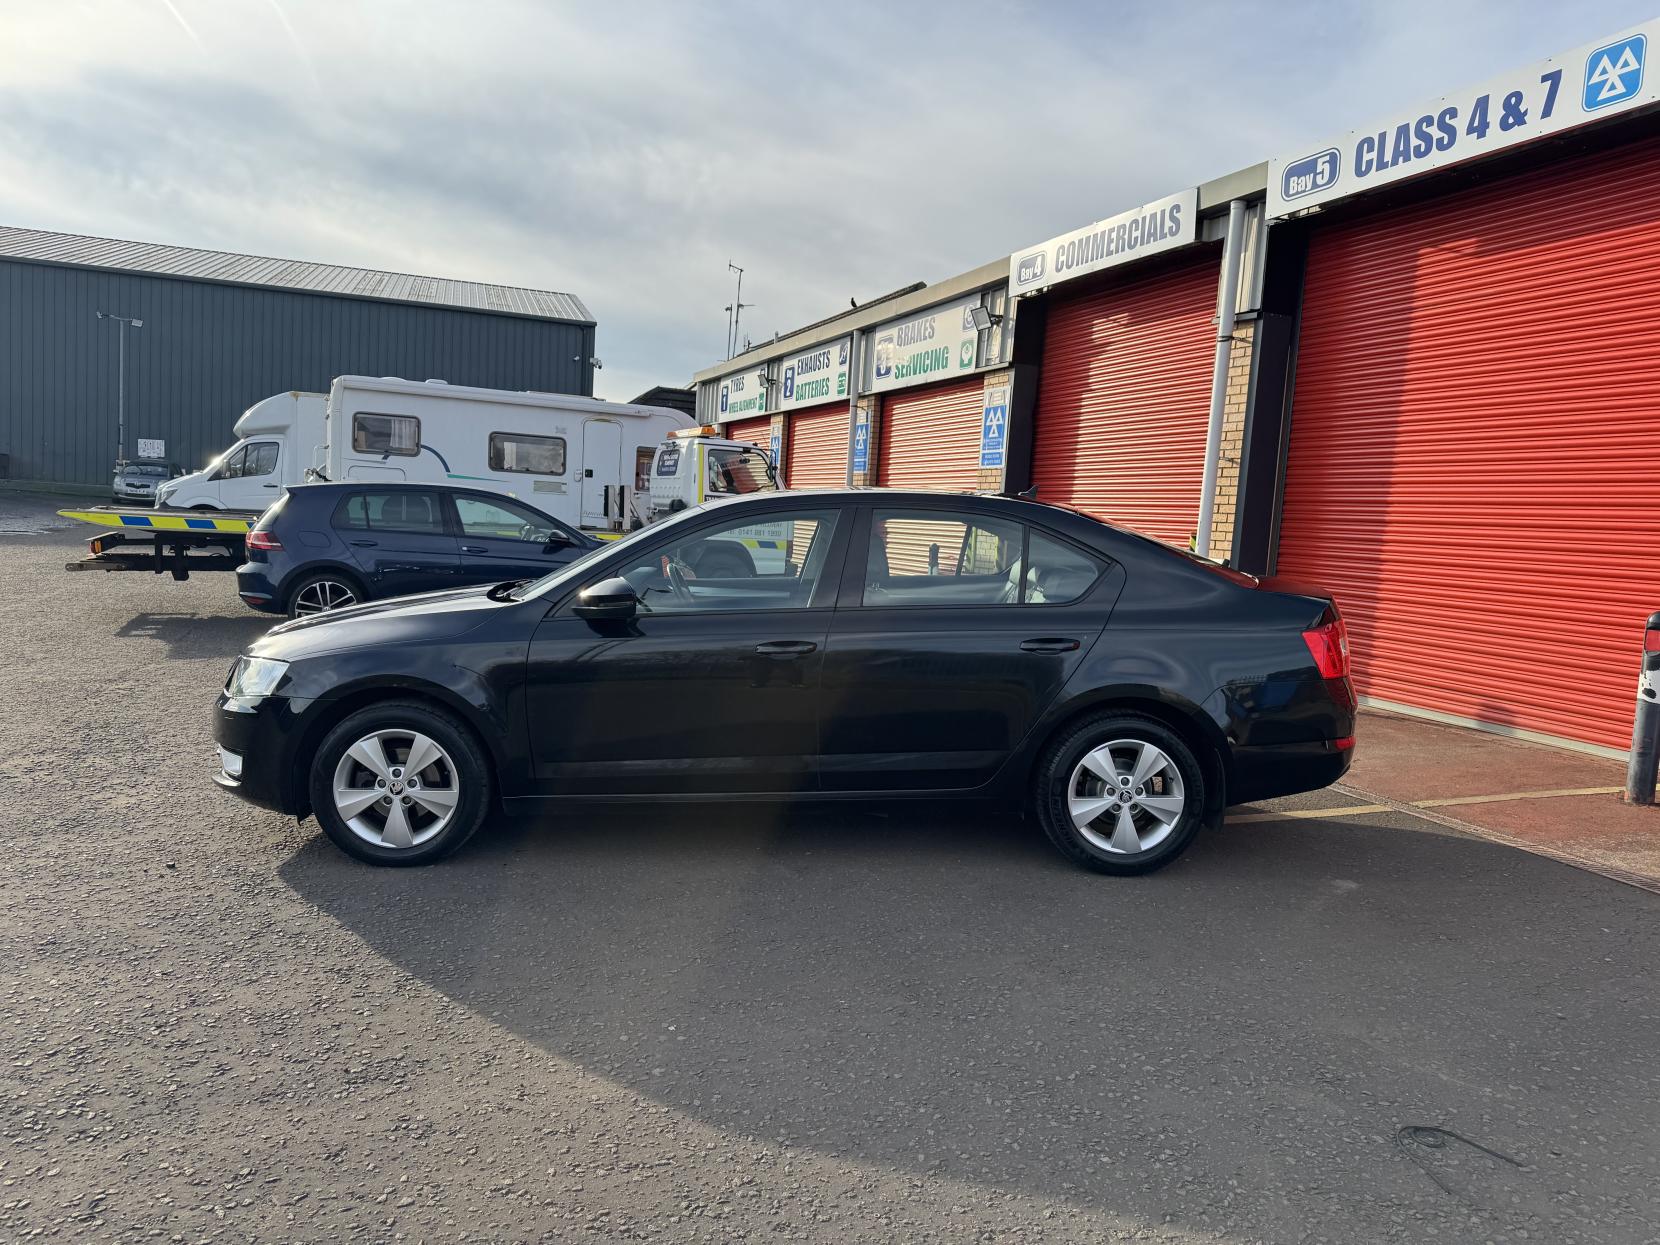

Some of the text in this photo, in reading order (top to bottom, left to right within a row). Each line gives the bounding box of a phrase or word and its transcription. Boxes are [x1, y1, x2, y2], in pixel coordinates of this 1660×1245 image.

[1354, 68, 1563, 178] CLASS 4 & 7
[1288, 154, 1331, 196] Bay 5
[1054, 203, 1182, 273] COMMERCIALS
[1020, 255, 1042, 281] Bay 4
[897, 316, 936, 348] BRAKES
[797, 350, 831, 376] EXHAUSTS
[894, 346, 950, 380] SERVICING
[730, 376, 745, 394] TYRES
[786, 379, 792, 397] 2
[795, 377, 830, 401] BATTERIES
